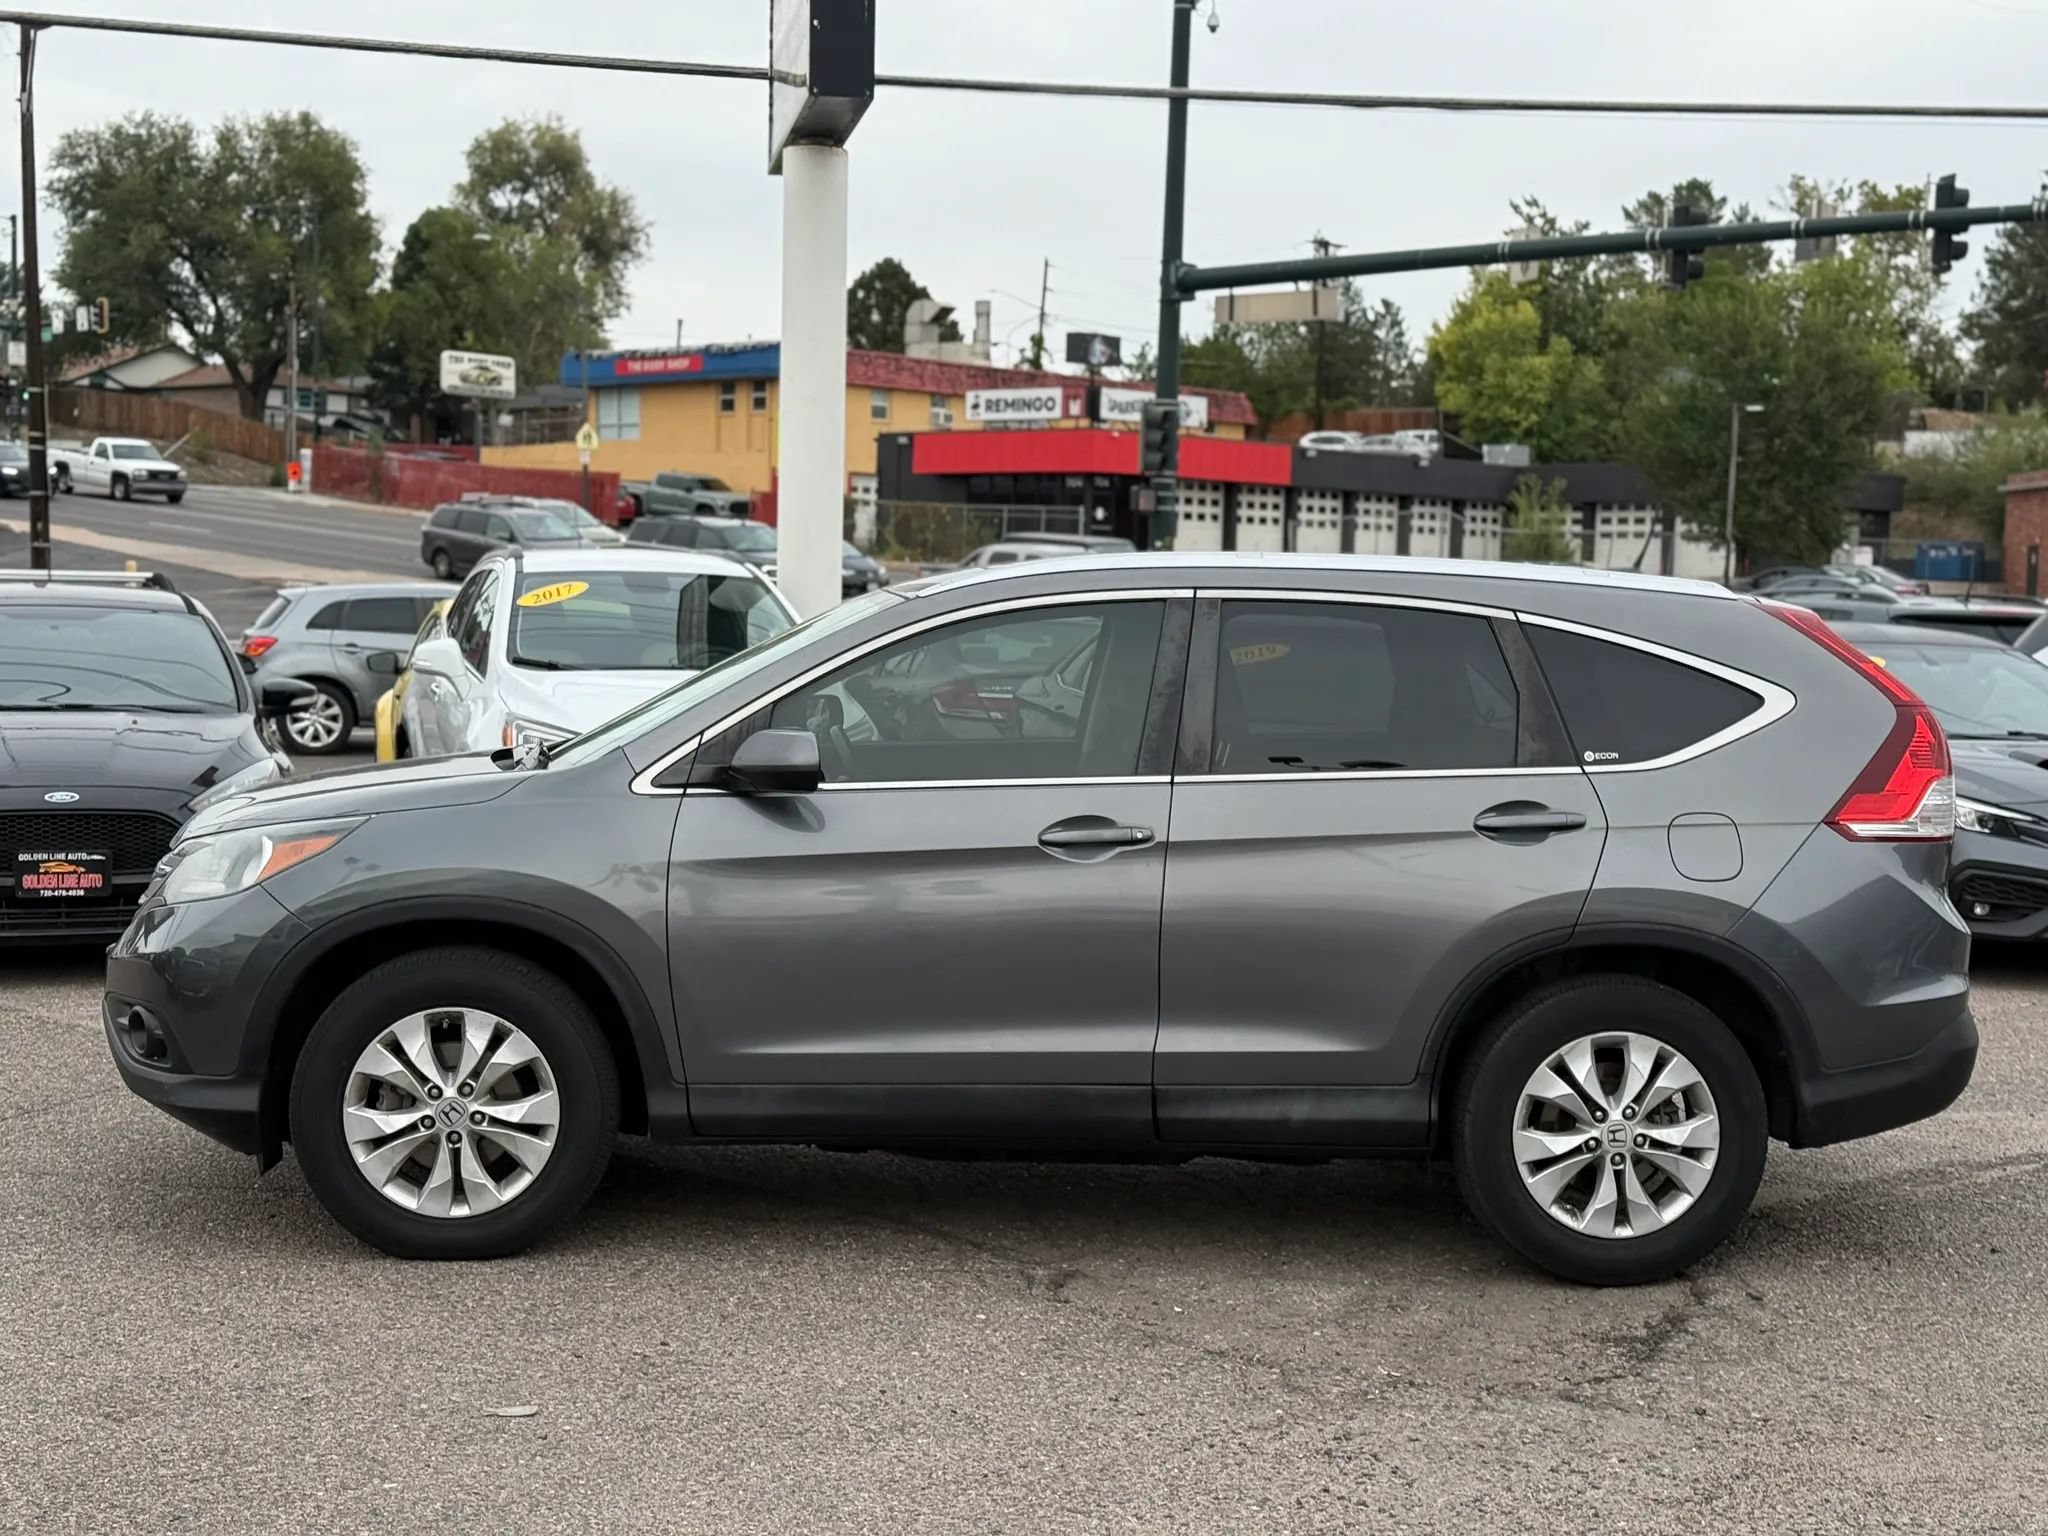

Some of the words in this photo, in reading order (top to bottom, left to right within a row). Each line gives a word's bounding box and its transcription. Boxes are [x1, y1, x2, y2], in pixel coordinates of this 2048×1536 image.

[984, 395, 1056, 413] REMINGO
[530, 583, 573, 604] 2017
[1595, 751, 1619, 760] ECON
[18, 853, 48, 861] GOLDEN
[22, 874, 58, 889] GOLDEN
[58, 874, 79, 888] LINE
[79, 873, 103, 888] AUTO
